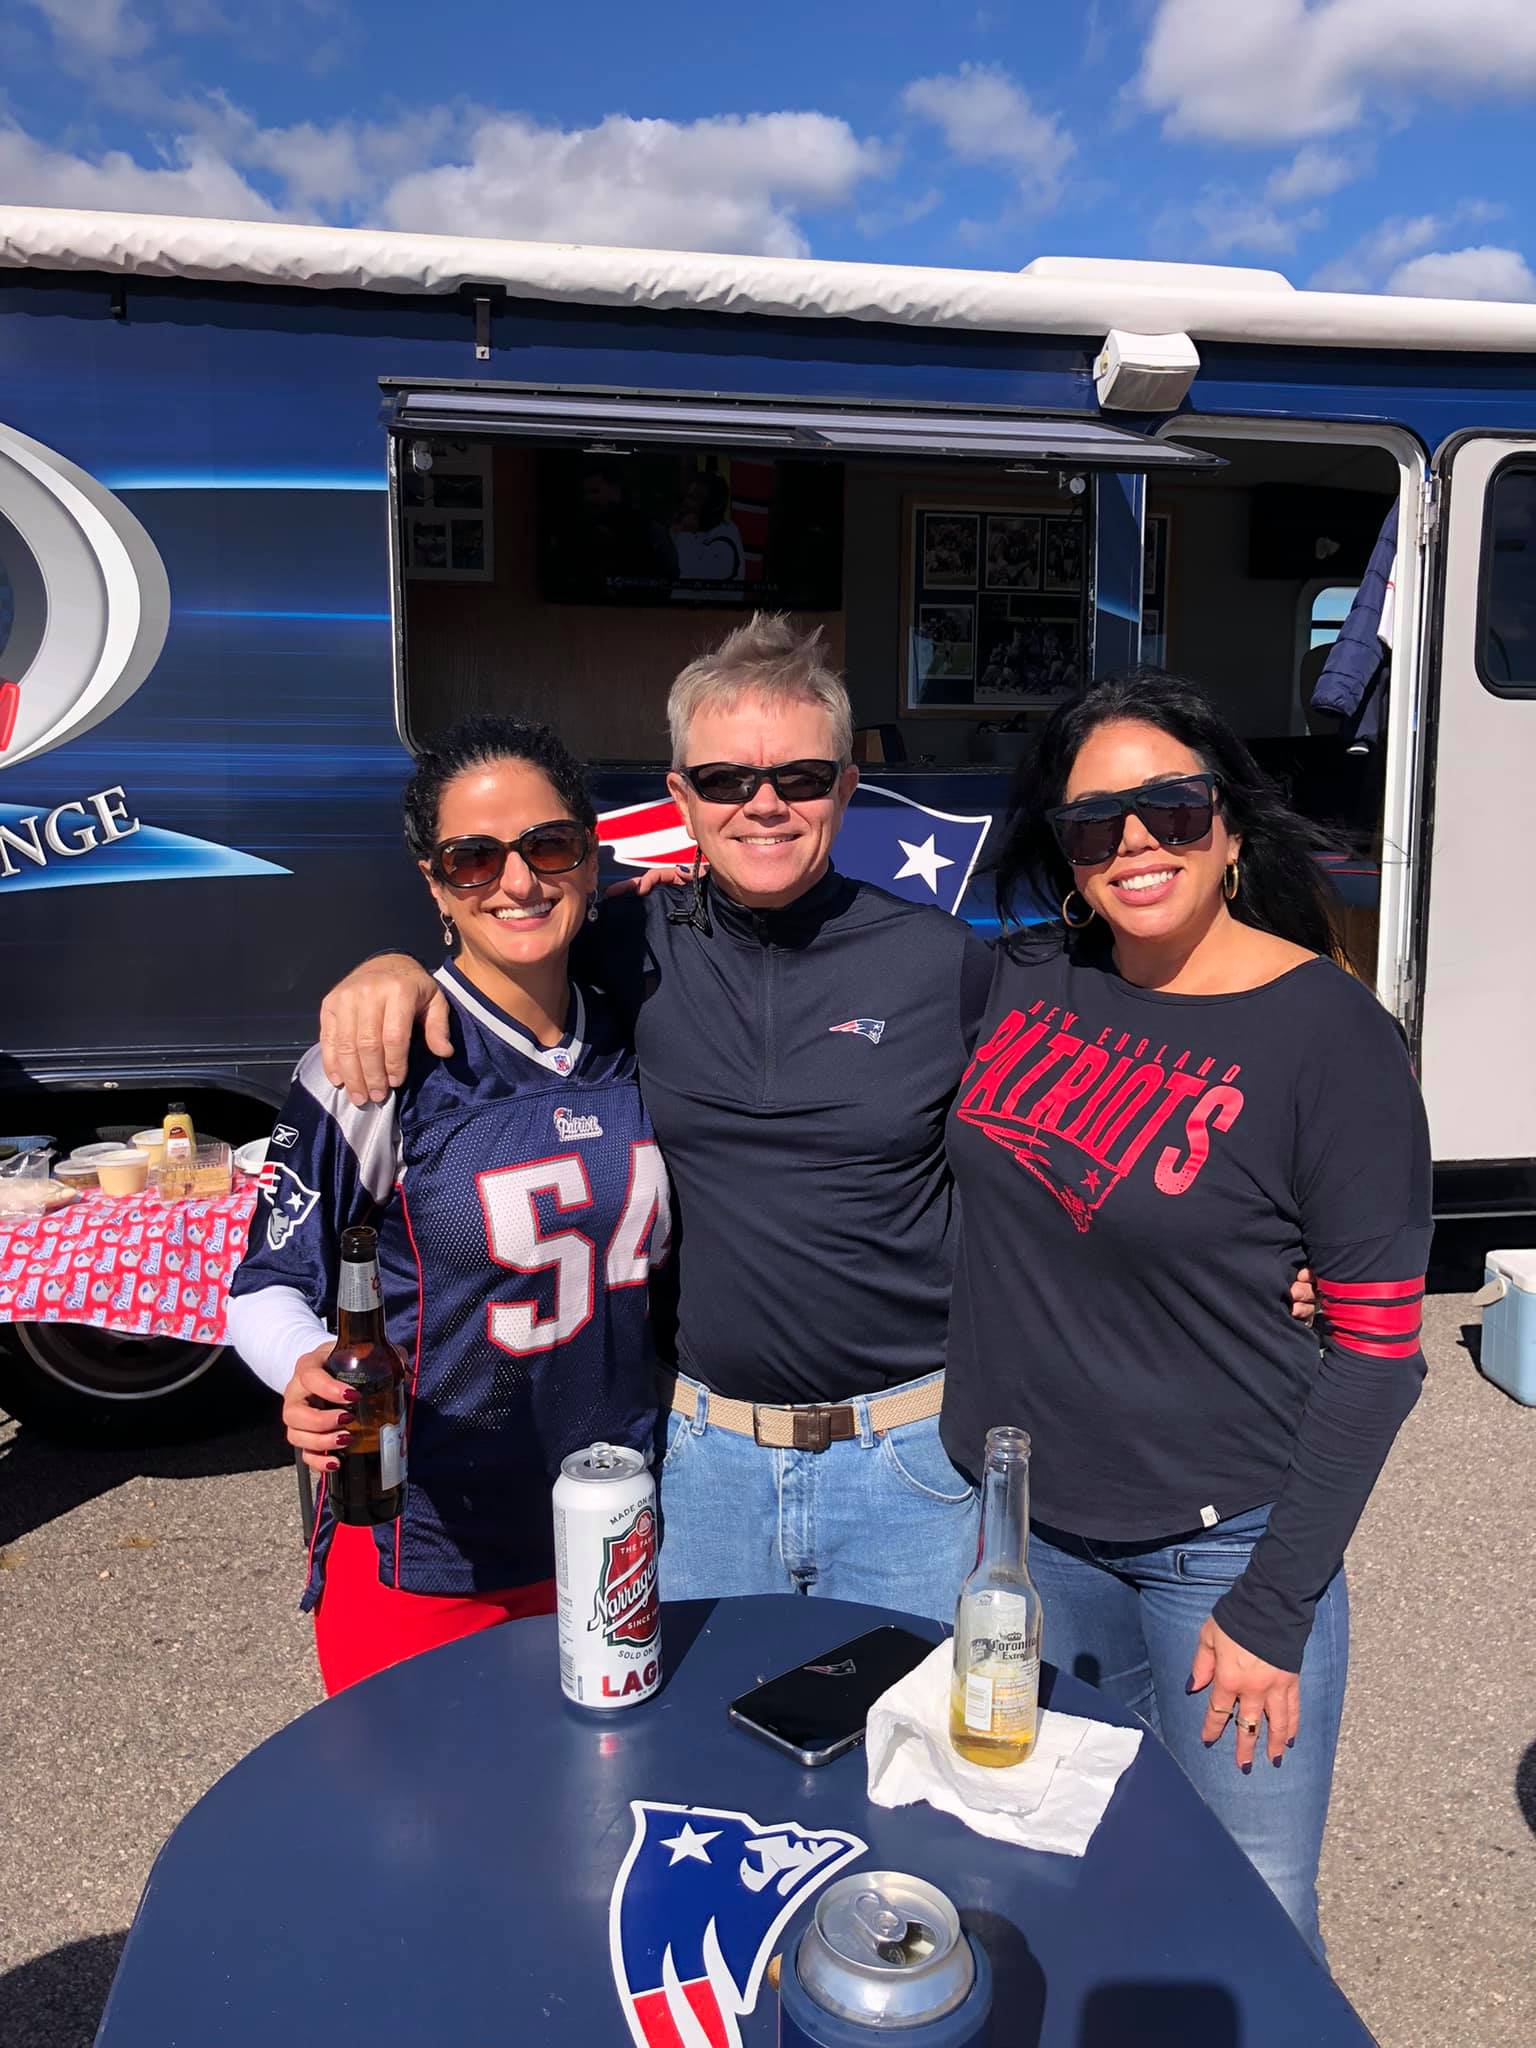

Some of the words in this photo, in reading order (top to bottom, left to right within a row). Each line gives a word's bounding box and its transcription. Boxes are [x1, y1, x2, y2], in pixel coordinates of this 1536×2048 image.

[1029, 1000, 1079, 1031] NEW
[1097, 1027, 1242, 1083] ENGLAND
[961, 1009, 1244, 1195] PATRIOTS
[556, 1114, 603, 1142] Patriots
[474, 1139, 672, 1357] 54
[610, 1504, 636, 1525] MADE
[637, 1496, 648, 1508] ON
[619, 1544, 638, 1555] THE
[628, 1613, 651, 1629] SINCE
[618, 1650, 641, 1660] SOLD
